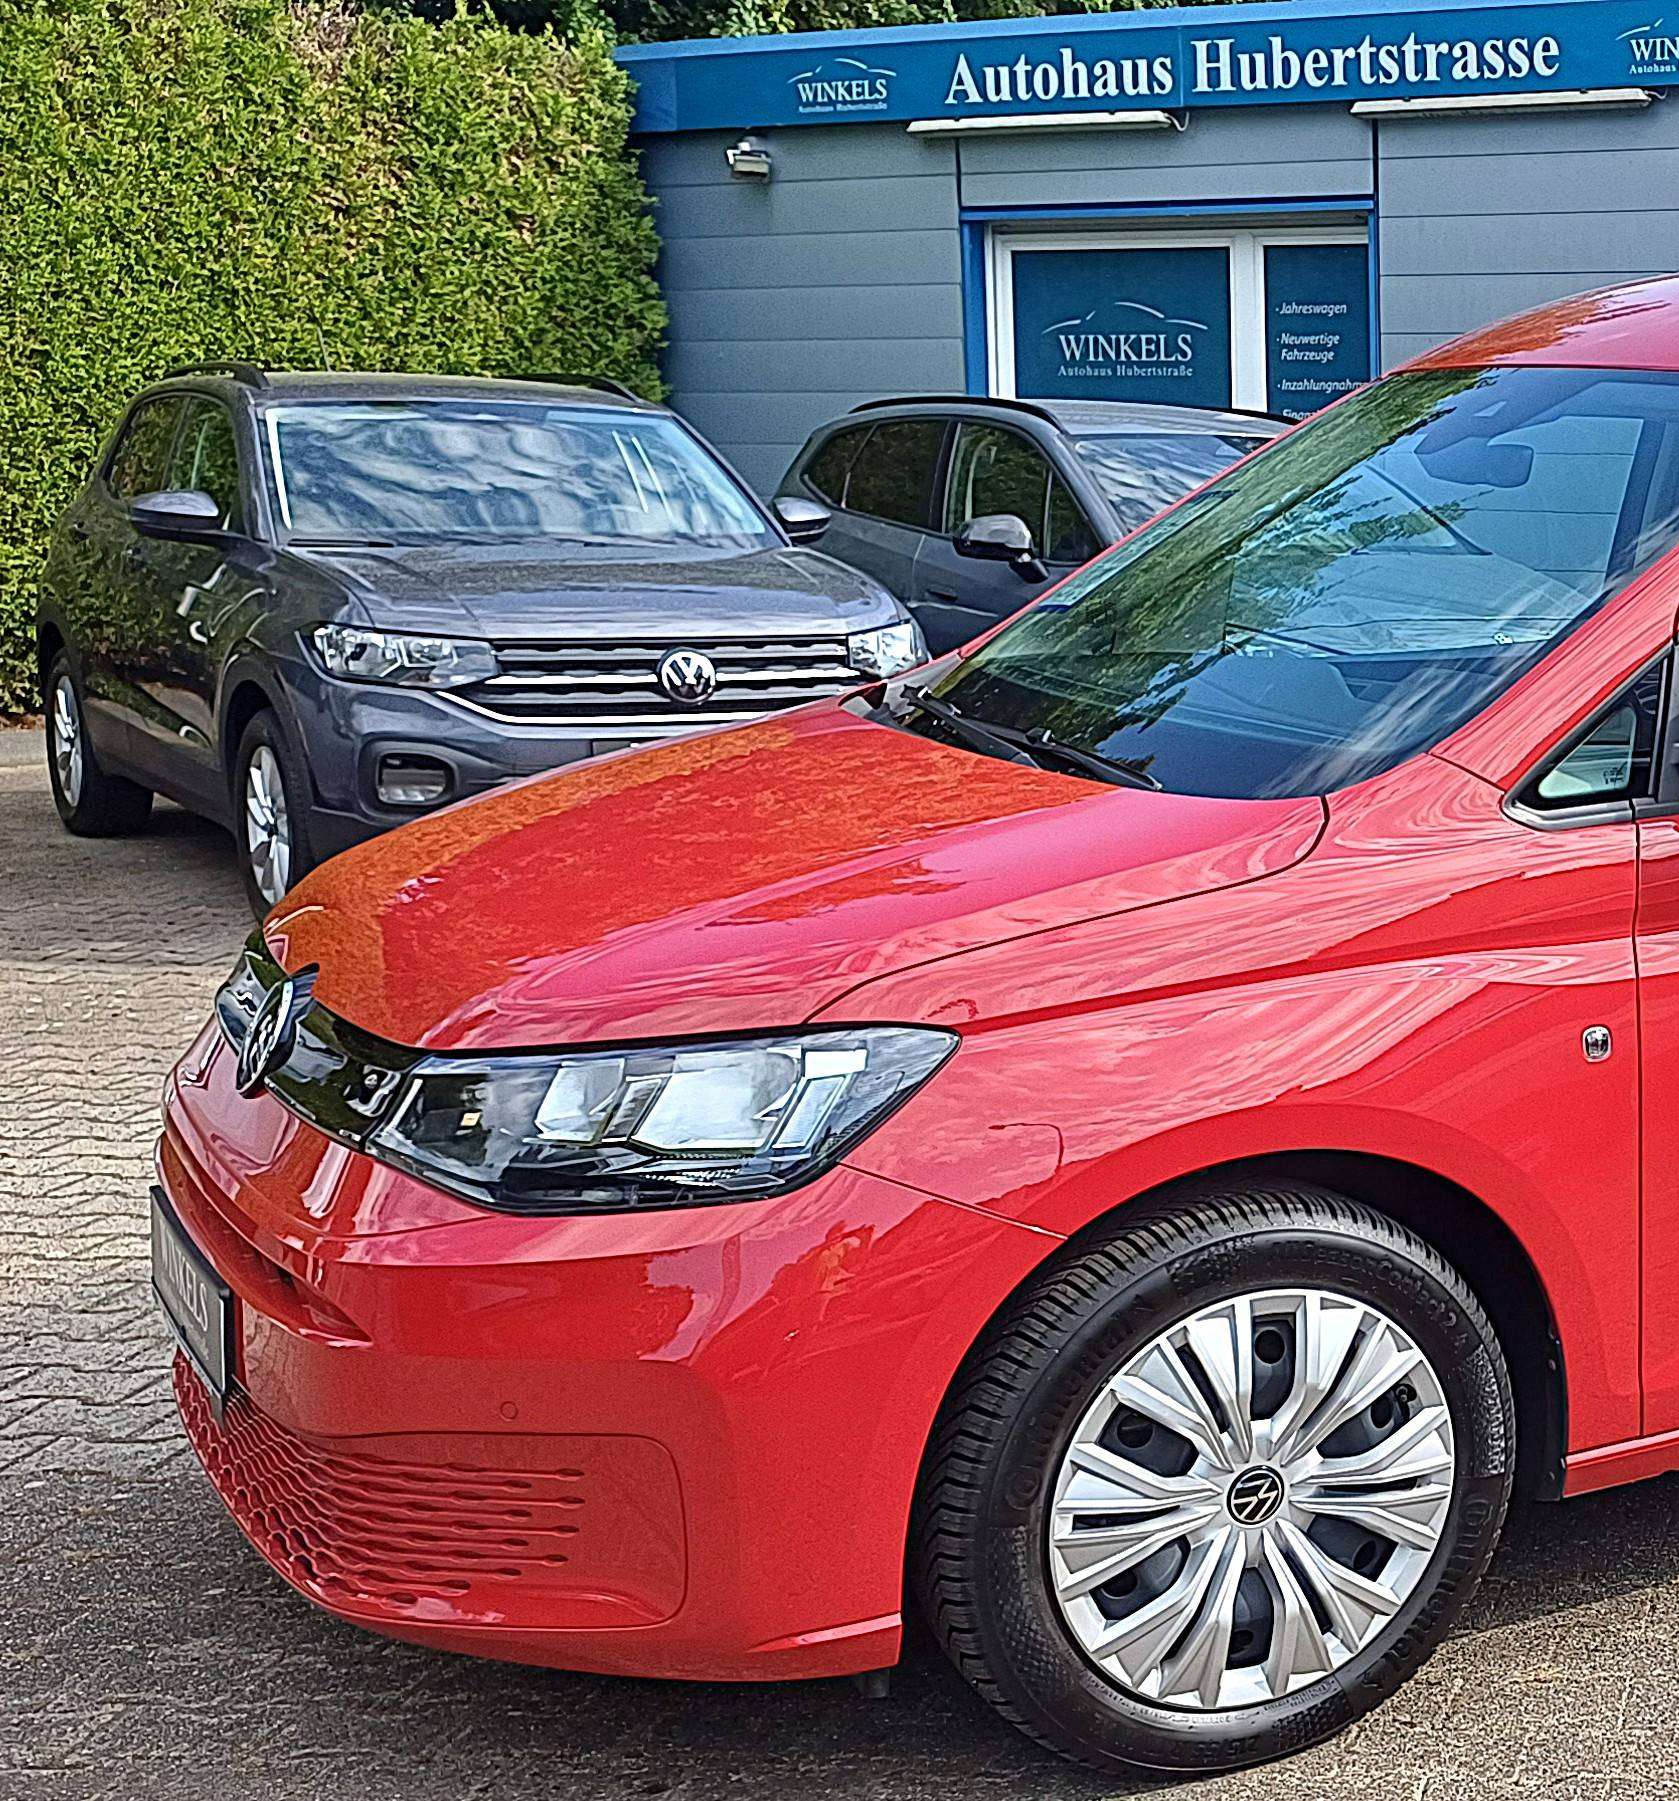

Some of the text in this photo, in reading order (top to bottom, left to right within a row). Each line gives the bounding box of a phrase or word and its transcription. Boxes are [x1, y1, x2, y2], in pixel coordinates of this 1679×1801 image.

[944, 32, 1560, 105] Autohaus Hubertstrasse
[1629, 63, 1677, 75] Autohaus
[797, 79, 888, 103] WINKELS
[1058, 333, 1193, 362] WINKELS
[1281, 349, 1335, 363] Fahrzeuge
[1058, 364, 1193, 377] Autohaus Hubertstraße
